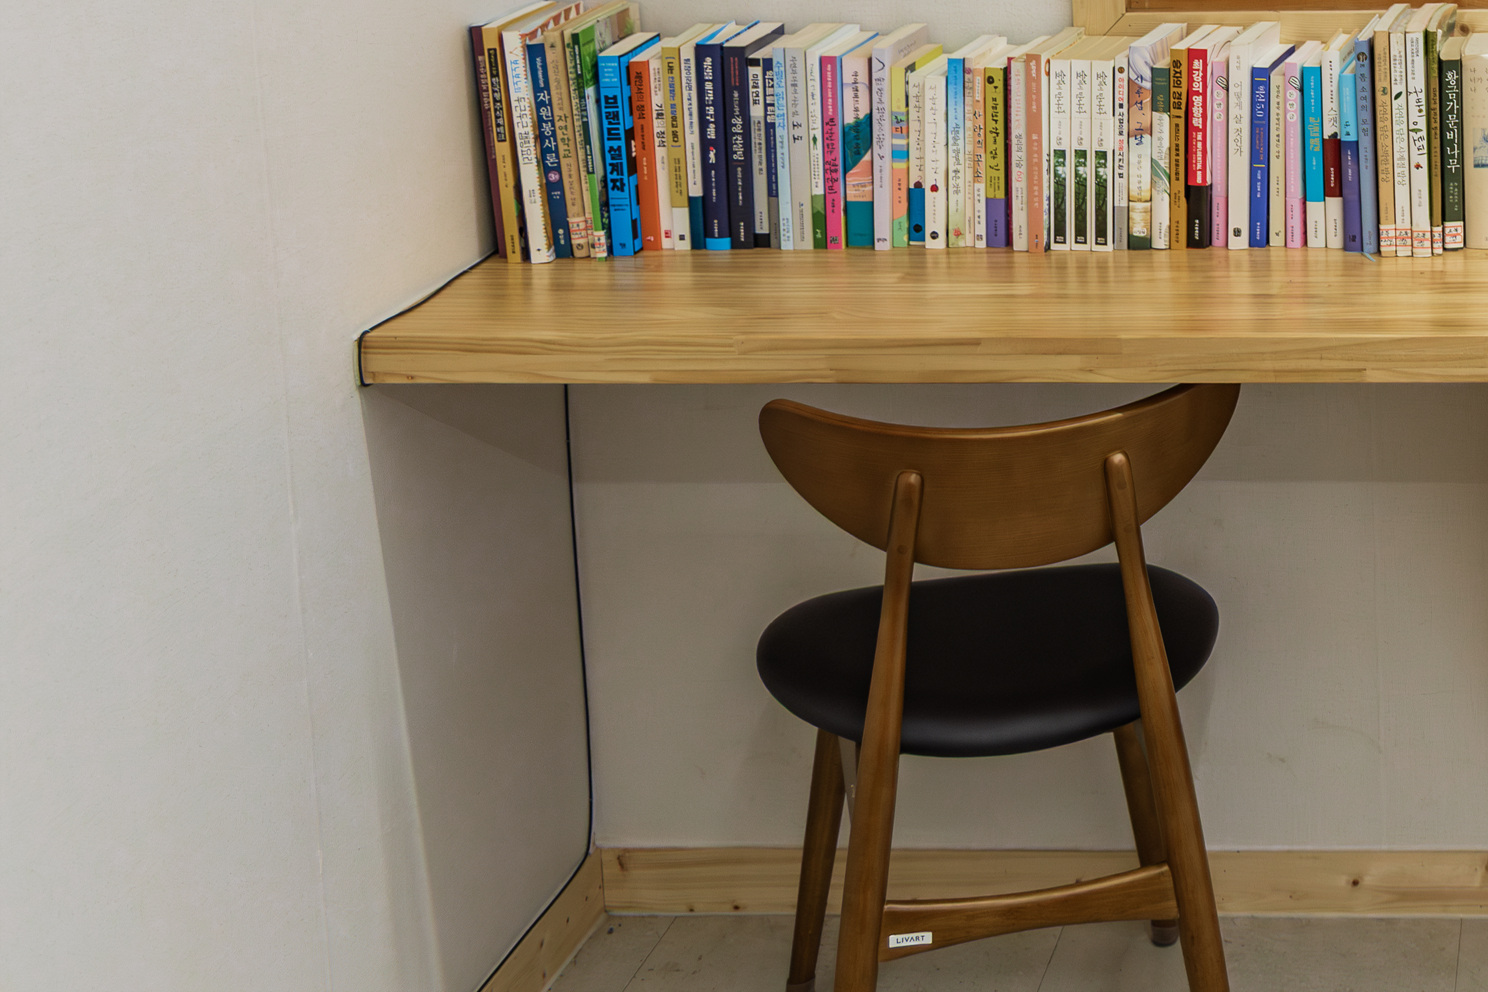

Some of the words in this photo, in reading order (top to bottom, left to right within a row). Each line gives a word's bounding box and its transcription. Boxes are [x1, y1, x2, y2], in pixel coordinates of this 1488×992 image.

[510, 59, 521, 93] 보노보노의
[536, 56, 544, 88] Volunteerism
[684, 58, 692, 92] 팀장이라면
[703, 57, 712, 80] 혁신을
[790, 56, 798, 74] 자연과
[1172, 59, 1182, 88] 승자의
[1192, 59, 1202, 93] 최강의
[635, 71, 644, 102] 제안서의
[750, 74, 759, 88] 미래
[667, 62, 674, 75] 나는
[671, 130, 680, 143] 싶다
[704, 82, 714, 104] 이끄는
[752, 90, 760, 106] 연표
[792, 96, 799, 108] 사는
[1055, 92, 1065, 114] 만나다
[1076, 92, 1087, 114] 만나다
[1096, 92, 1106, 116] 만나다
[1172, 91, 1182, 110] 경영
[1234, 80, 1243, 110] 어떻게
[1255, 85, 1266, 102] 혁신
[1360, 86, 1368, 112] 소여의
[1408, 86, 1426, 118] 굿바이
[514, 96, 527, 128] 두근두근
[604, 95, 622, 141] 브랜드
[636, 104, 646, 120] 정석
[655, 104, 664, 128] 기획의
[706, 106, 715, 122] 인구
[991, 97, 999, 124] 피피와
[1192, 95, 1202, 129] 영향력
[1234, 114, 1244, 124] 살
[1256, 103, 1264, 118] 5.0
[1328, 108, 1338, 128] 스캣
[1379, 100, 1388, 124] 자연을
[1394, 103, 1404, 125] 자연을
[1445, 69, 1460, 174] 황금가문비나무
[537, 90, 559, 167] 자원봉사론
[707, 124, 716, 139] 혁명
[732, 116, 744, 132] 경영
[989, 126, 1000, 144] 함께
[1360, 118, 1368, 137] 모험
[1380, 125, 1388, 142] 담은
[1396, 126, 1404, 144] 담은
[518, 130, 533, 165] 캠핑요리
[656, 130, 666, 148] 정석
[732, 134, 744, 160] 컨설팅
[1015, 132, 1024, 152] 정리의
[1234, 127, 1244, 157] 것인가
[1016, 154, 1024, 168] 기술
[1380, 144, 1390, 166] 소박한
[1397, 146, 1406, 170] 사계절
[608, 146, 626, 192] 설계자
[825, 156, 838, 194] 결혼준비
[989, 162, 1000, 172] 길
[1015, 170, 1024, 182] 69
[1381, 167, 1390, 183] 밥상
[1398, 170, 1407, 186] 밥상
[896, 934, 926, 944] LIVART
